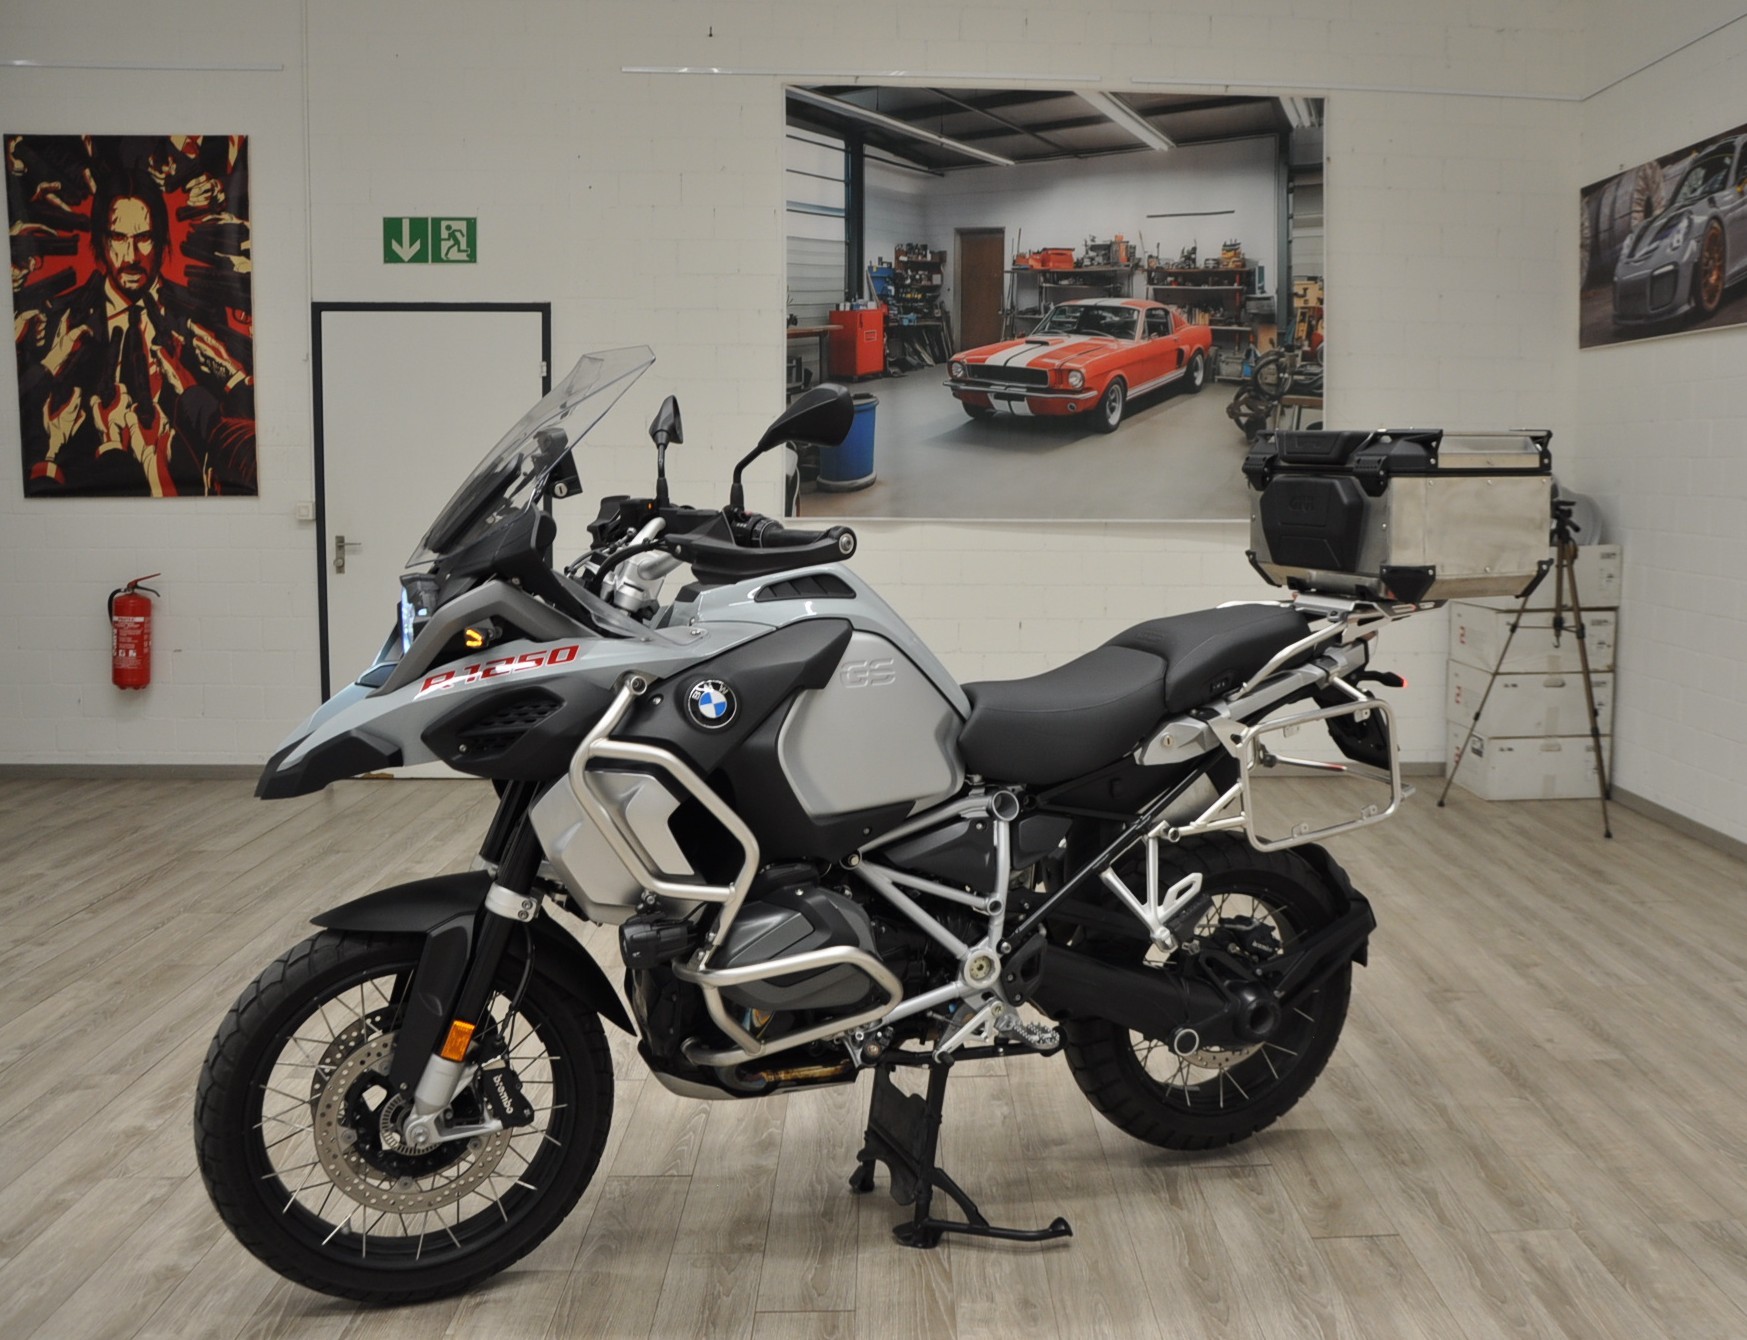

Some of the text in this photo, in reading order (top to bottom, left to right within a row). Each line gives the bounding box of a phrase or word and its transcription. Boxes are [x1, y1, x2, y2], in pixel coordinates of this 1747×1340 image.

[464, 645, 580, 683] 1250
[840, 657, 896, 689] GS
[691, 681, 729, 701] BMW
[493, 1073, 513, 1114] brembo
